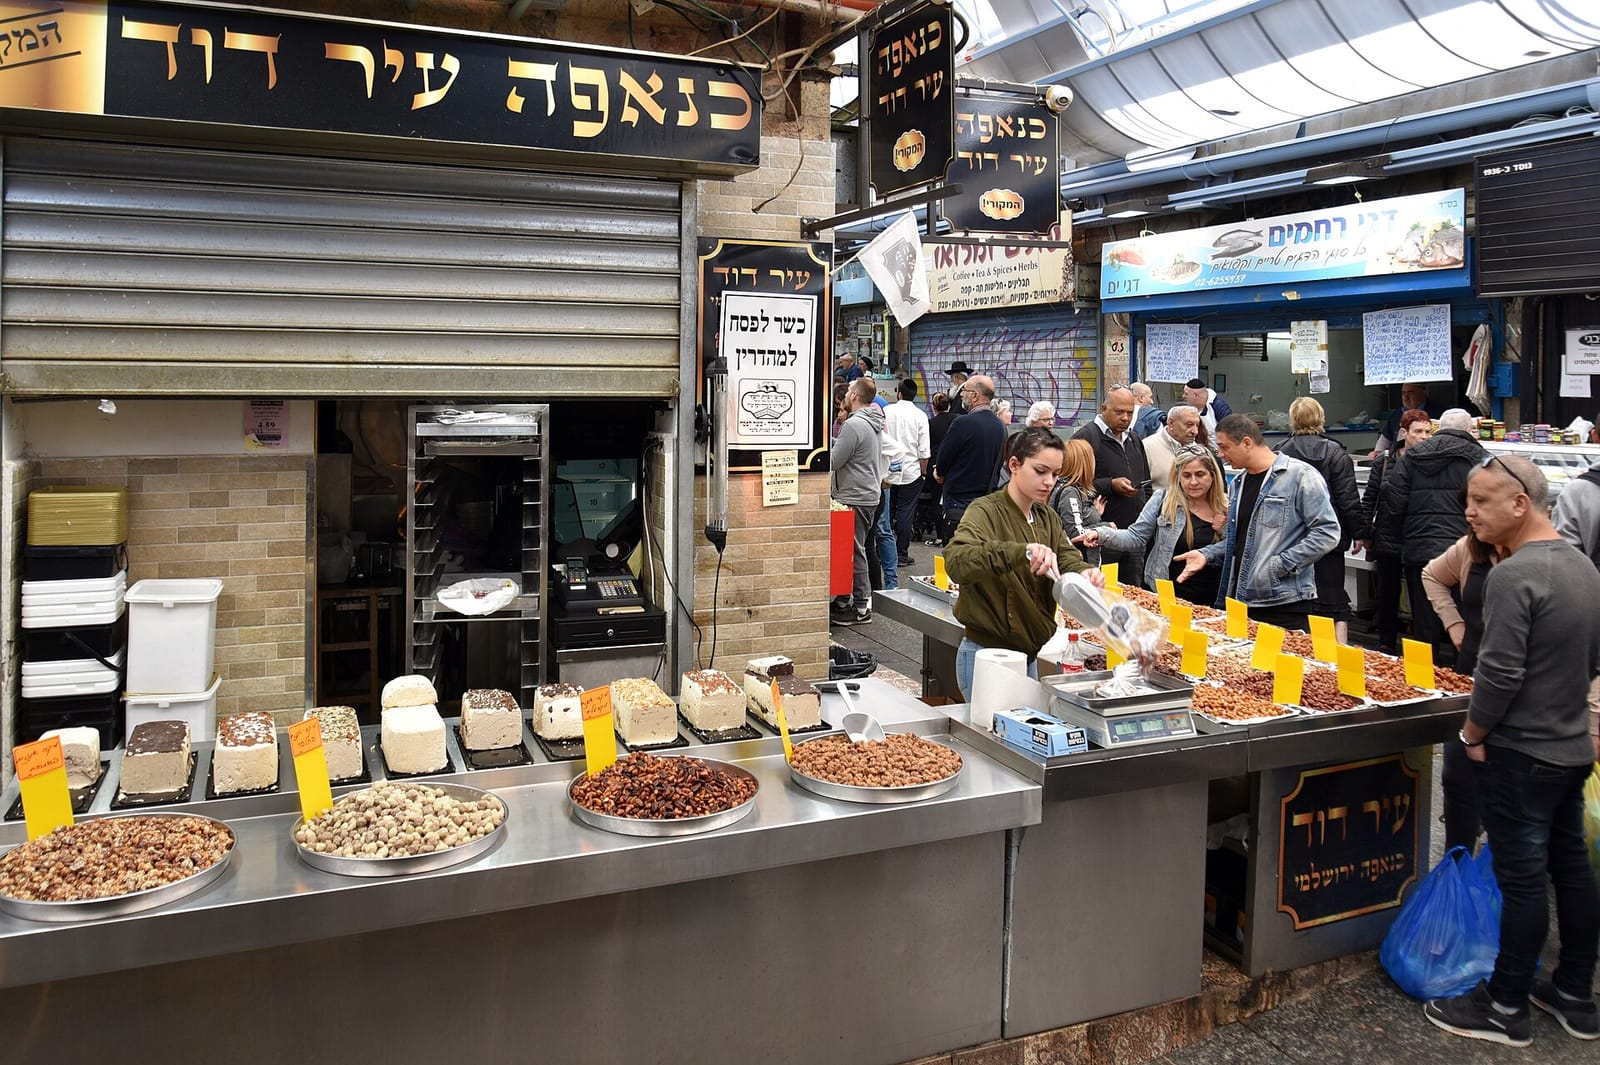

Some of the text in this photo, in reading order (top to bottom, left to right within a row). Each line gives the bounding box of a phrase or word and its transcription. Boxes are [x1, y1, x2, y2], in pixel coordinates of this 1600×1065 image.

[878, 20, 942, 78] כנאפה
[121, 15, 753, 138] כנאפה עיר דוד
[879, 70, 944, 117] עיר דוד
[956, 112, 1047, 144] כנאפה
[895, 141, 922, 161] המקורי!
[957, 150, 1048, 176] עיר דוד
[983, 198, 1021, 212] המקורי!
[1268, 216, 1347, 248] רחמים
[952, 270, 971, 281] Coffee
[976, 269, 986, 278] Tea
[993, 264, 1013, 278] Spices
[1018, 261, 1038, 271] Herbs
[1254, 247, 1287, 270] טריים
[1284, 250, 1320, 269] הדגים
[713, 266, 811, 290] עיר דוד
[1008, 278, 1030, 290] תבלינים
[729, 308, 806, 334] כשר לפסח
[735, 343, 798, 370] למהדרין
[1292, 793, 1411, 848] עיר דוד
[1294, 853, 1405, 892] כנאפה ירושלמי
